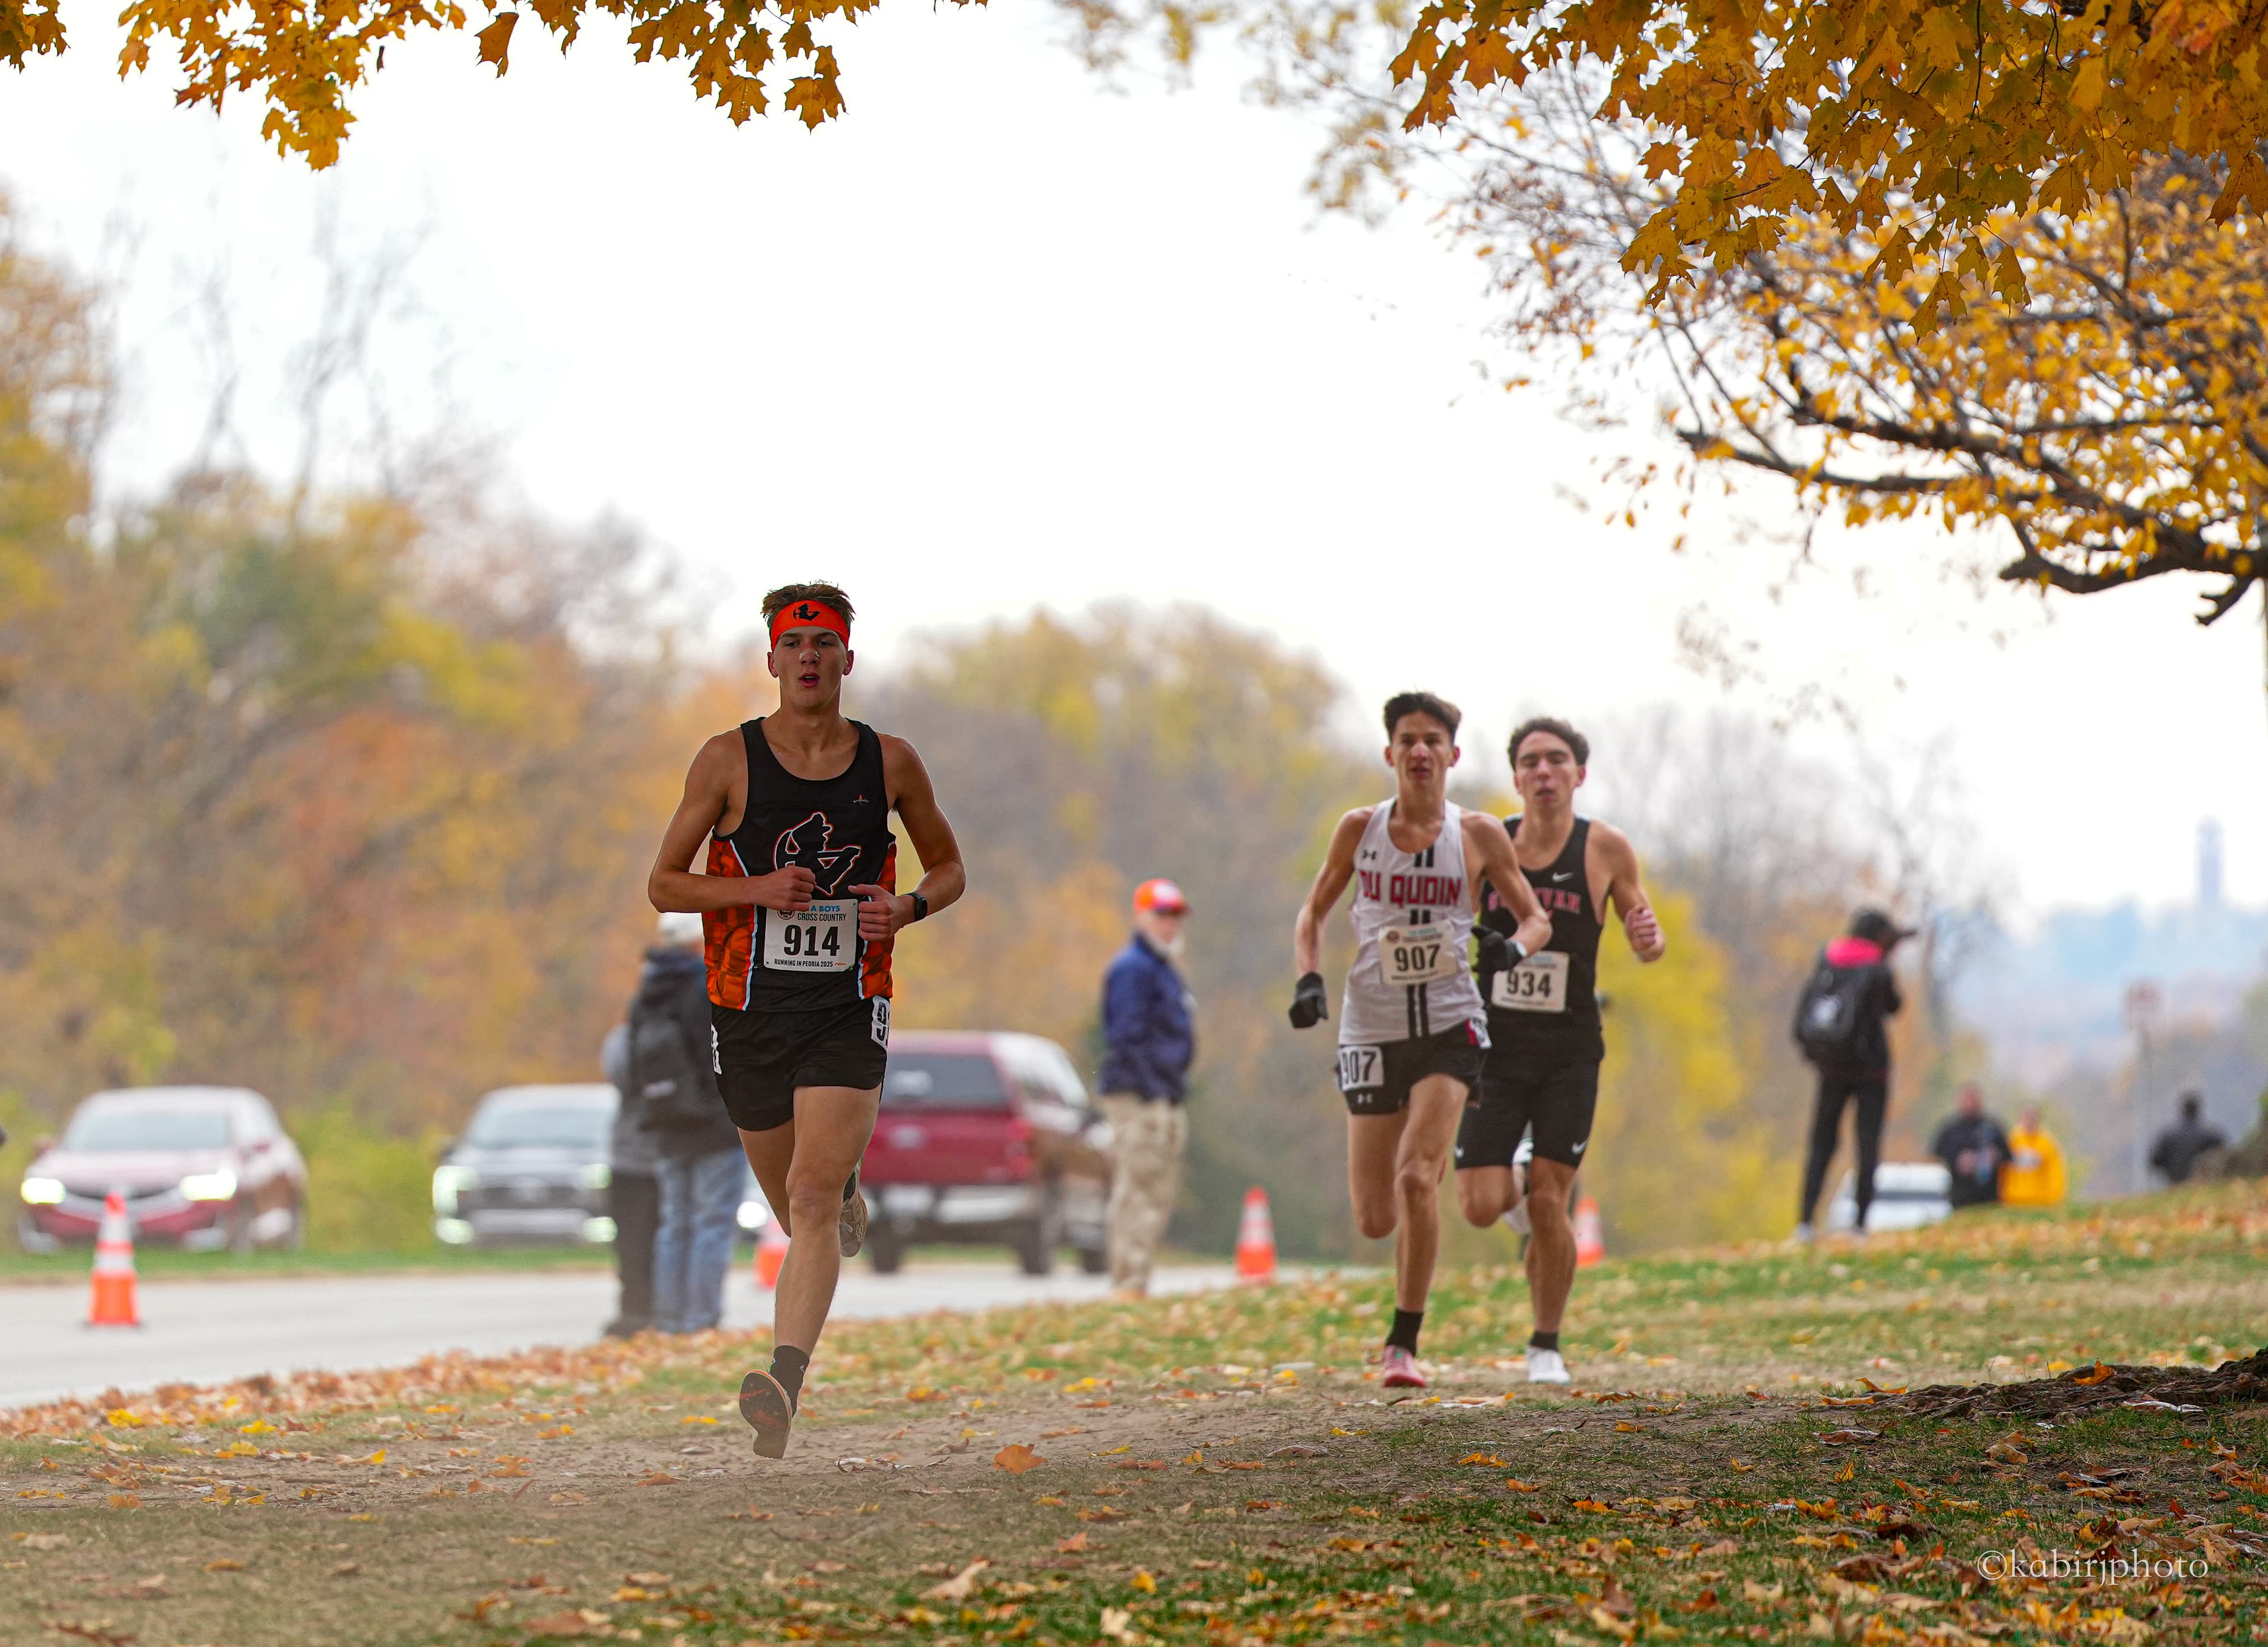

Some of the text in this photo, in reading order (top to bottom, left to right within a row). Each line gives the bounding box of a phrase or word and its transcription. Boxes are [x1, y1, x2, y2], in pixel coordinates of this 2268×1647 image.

[797, 912, 847, 922] CROSS COUNTRY
[784, 924, 840, 957] 914
[774, 958, 796, 967] RUNNING
[1394, 943, 1441, 973] 907
[1506, 970, 1552, 998] 934
